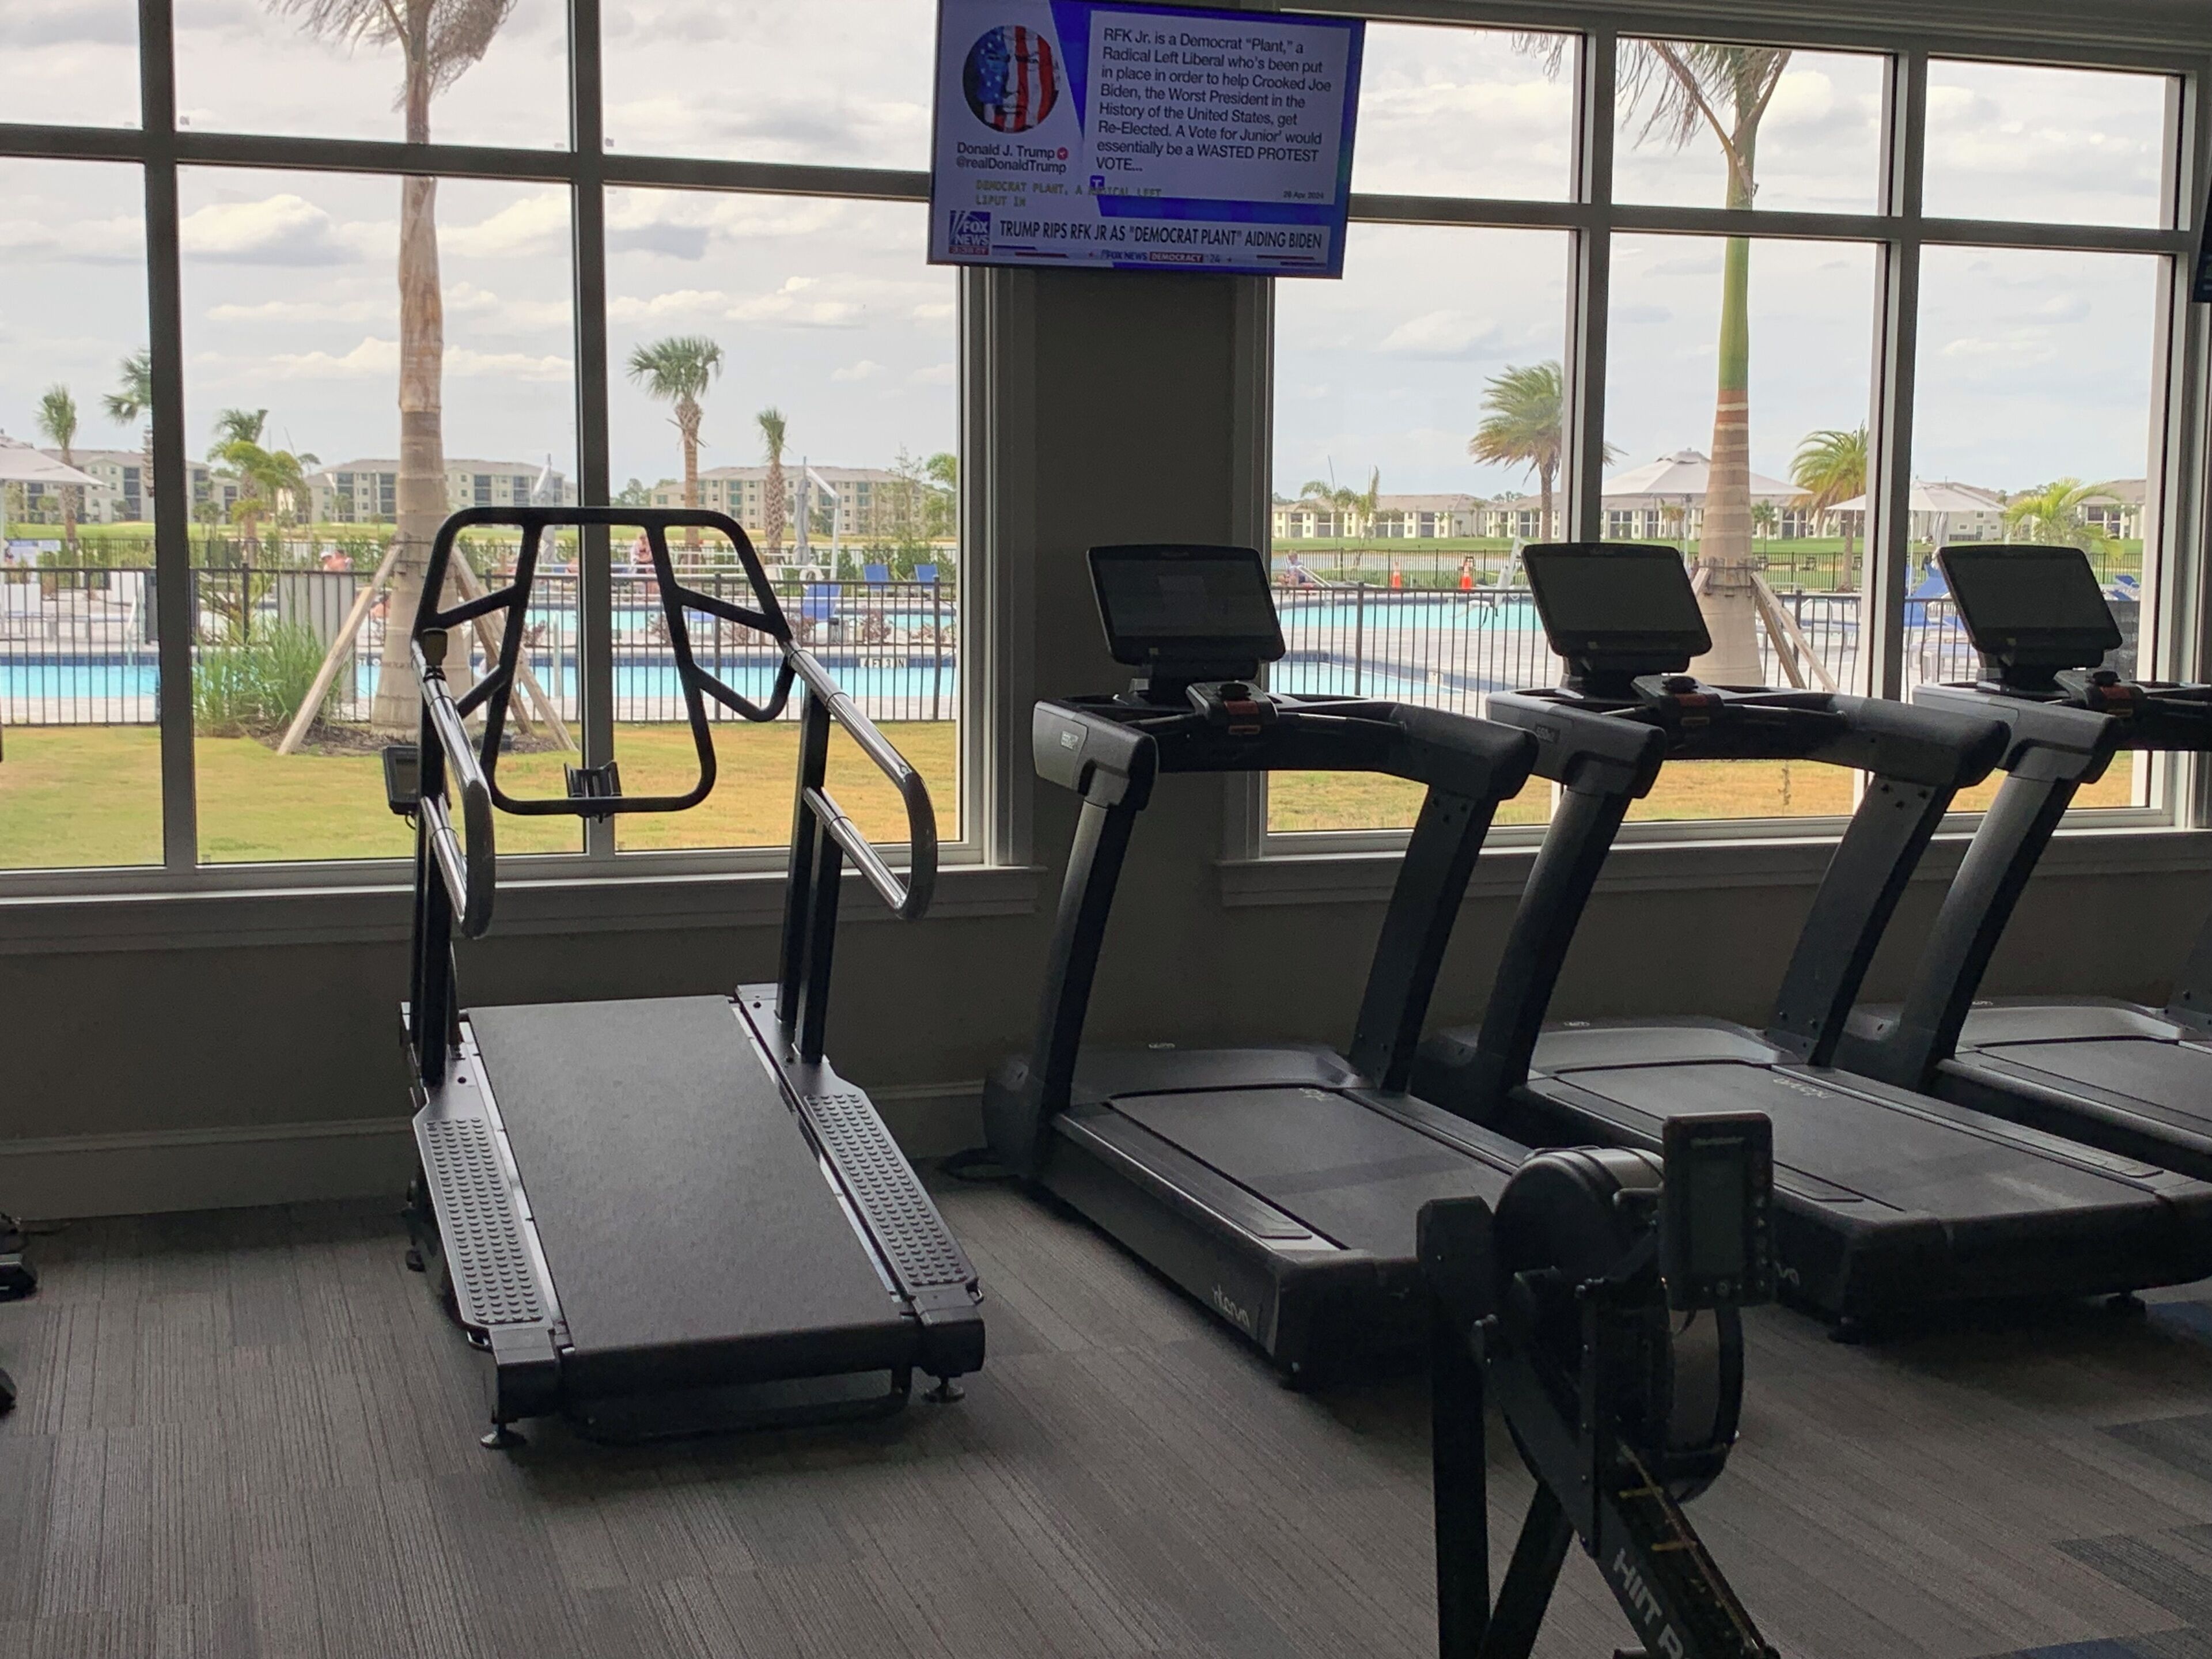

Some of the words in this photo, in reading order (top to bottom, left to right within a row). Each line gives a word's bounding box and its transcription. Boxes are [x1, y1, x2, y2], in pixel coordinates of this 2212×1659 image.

[1104, 27, 1132, 42] RFK
[1135, 29, 1151, 44] Jr.
[1155, 31, 1165, 44] is
[1169, 35, 1176, 46] a
[1180, 32, 1242, 50] Democrat
[1296, 43, 1303, 54] a
[1103, 46, 1151, 62] Radical
[1154, 50, 1179, 64] Left
[1182, 52, 1224, 67] Liberal
[1268, 58, 1298, 71] been
[1302, 62, 1323, 74] put
[1101, 65, 1112, 78] in
[1116, 66, 1152, 82] place
[1155, 68, 1166, 82] in
[1169, 70, 1203, 84] order
[1207, 73, 1219, 85] to
[1222, 73, 1249, 89] help
[1252, 75, 1305, 90] Crooked
[1308, 78, 1332, 92] Joe
[1101, 84, 1141, 100] Biden,
[1145, 86, 1165, 100] the
[1168, 88, 1206, 103] Worst
[1210, 90, 1267, 106] President
[1271, 93, 1282, 107] in
[1286, 94, 1305, 108] the
[1099, 101, 1145, 120] History
[1147, 105, 1161, 118] of
[1164, 106, 1184, 119] the
[1187, 107, 1228, 122] United
[1232, 109, 1274, 125] States,
[1277, 113, 1297, 128] get
[1098, 120, 1172, 137] Re-Elected.
[1175, 125, 1185, 137] A
[1188, 126, 1217, 139] Vote
[1220, 127, 1237, 140] for
[1285, 132, 1322, 145] would
[957, 142, 999, 156] Donald
[1002, 145, 1013, 157] J.
[1017, 145, 1055, 161] Trump
[1097, 141, 1164, 157] essentially
[1166, 143, 1182, 156] be
[1185, 146, 1194, 157] a
[1197, 143, 1255, 159] WASTED
[1257, 147, 1319, 162] PROTEST
[956, 156, 1067, 175] @realDonaldTrump
[1096, 157, 1143, 172] VOTE...
[975, 179, 1027, 192] DEMOCRAT
[1032, 183, 1068, 195] PLANT,
[1075, 185, 1082, 195] A
[1294, 191, 1306, 200] Apr
[963, 221, 988, 233] FOX
[1000, 219, 1040, 237] TRUMP
[1043, 222, 1067, 239] RIPS
[1070, 224, 1091, 240] RFK
[1094, 224, 1107, 241] JR
[1109, 225, 1126, 241] AS
[1244, 231, 1286, 248] AIDING
[1289, 233, 1323, 249] BIDEN
[955, 234, 990, 247] NEWS
[1106, 252, 1123, 260] FOX
[1124, 252, 1148, 260] NEWS
[1152, 253, 1202, 262] DEMOCRACY
[1613, 1547, 1664, 1627] HIIT
